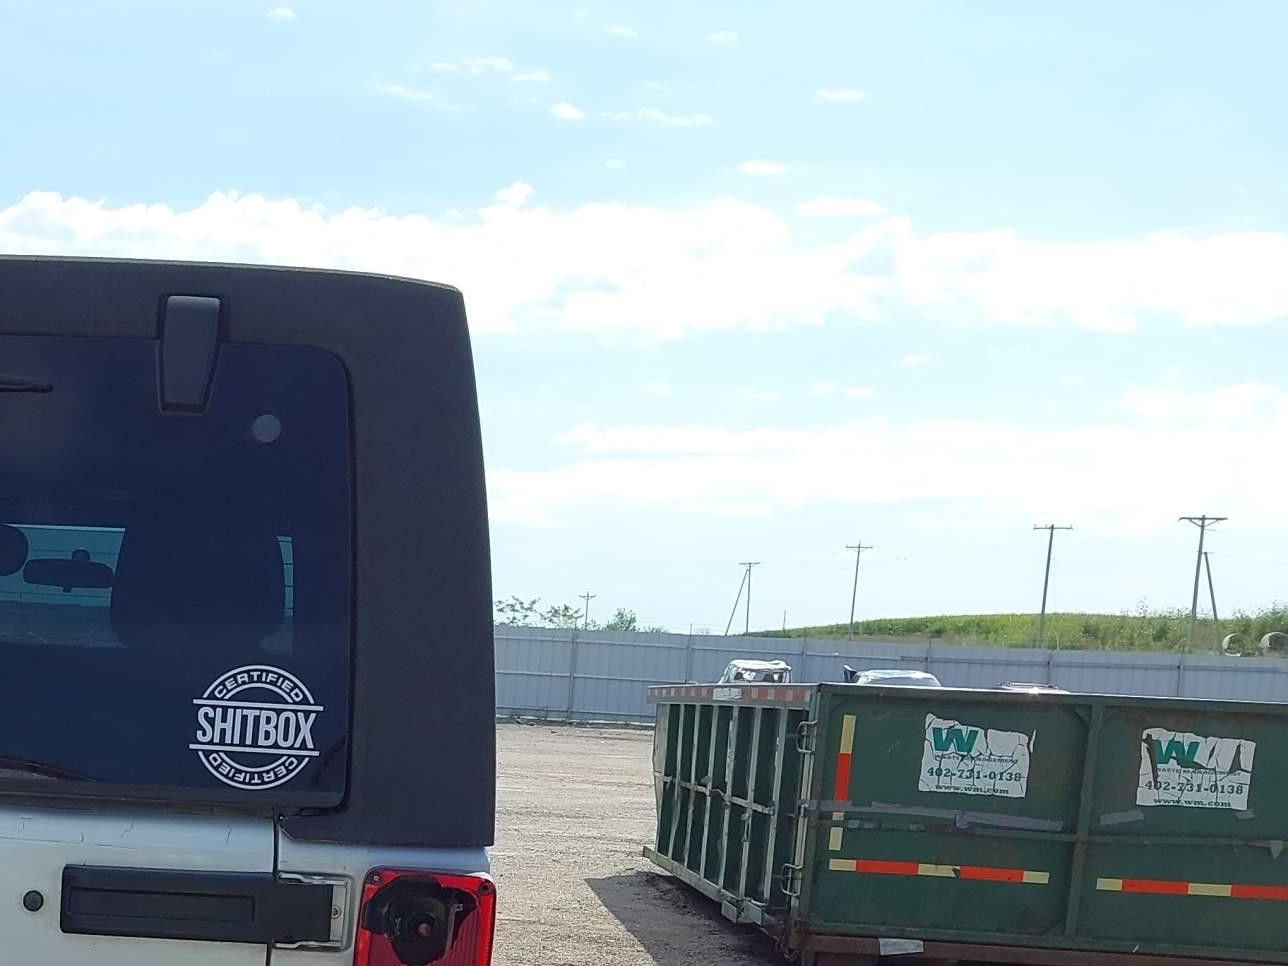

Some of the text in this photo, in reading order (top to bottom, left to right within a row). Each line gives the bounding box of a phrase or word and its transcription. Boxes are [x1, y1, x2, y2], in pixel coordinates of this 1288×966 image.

[214, 671, 304, 703] CERTIFIED
[196, 706, 316, 749] SHITBOX
[209, 753, 298, 784] CERTIFIED
[927, 767, 1022, 782] 402-731-0138
[935, 784, 1009, 795] www.wm.com
[1145, 781, 1244, 795] 402-731-0138
[1153, 798, 1232, 808] www.wm.com
